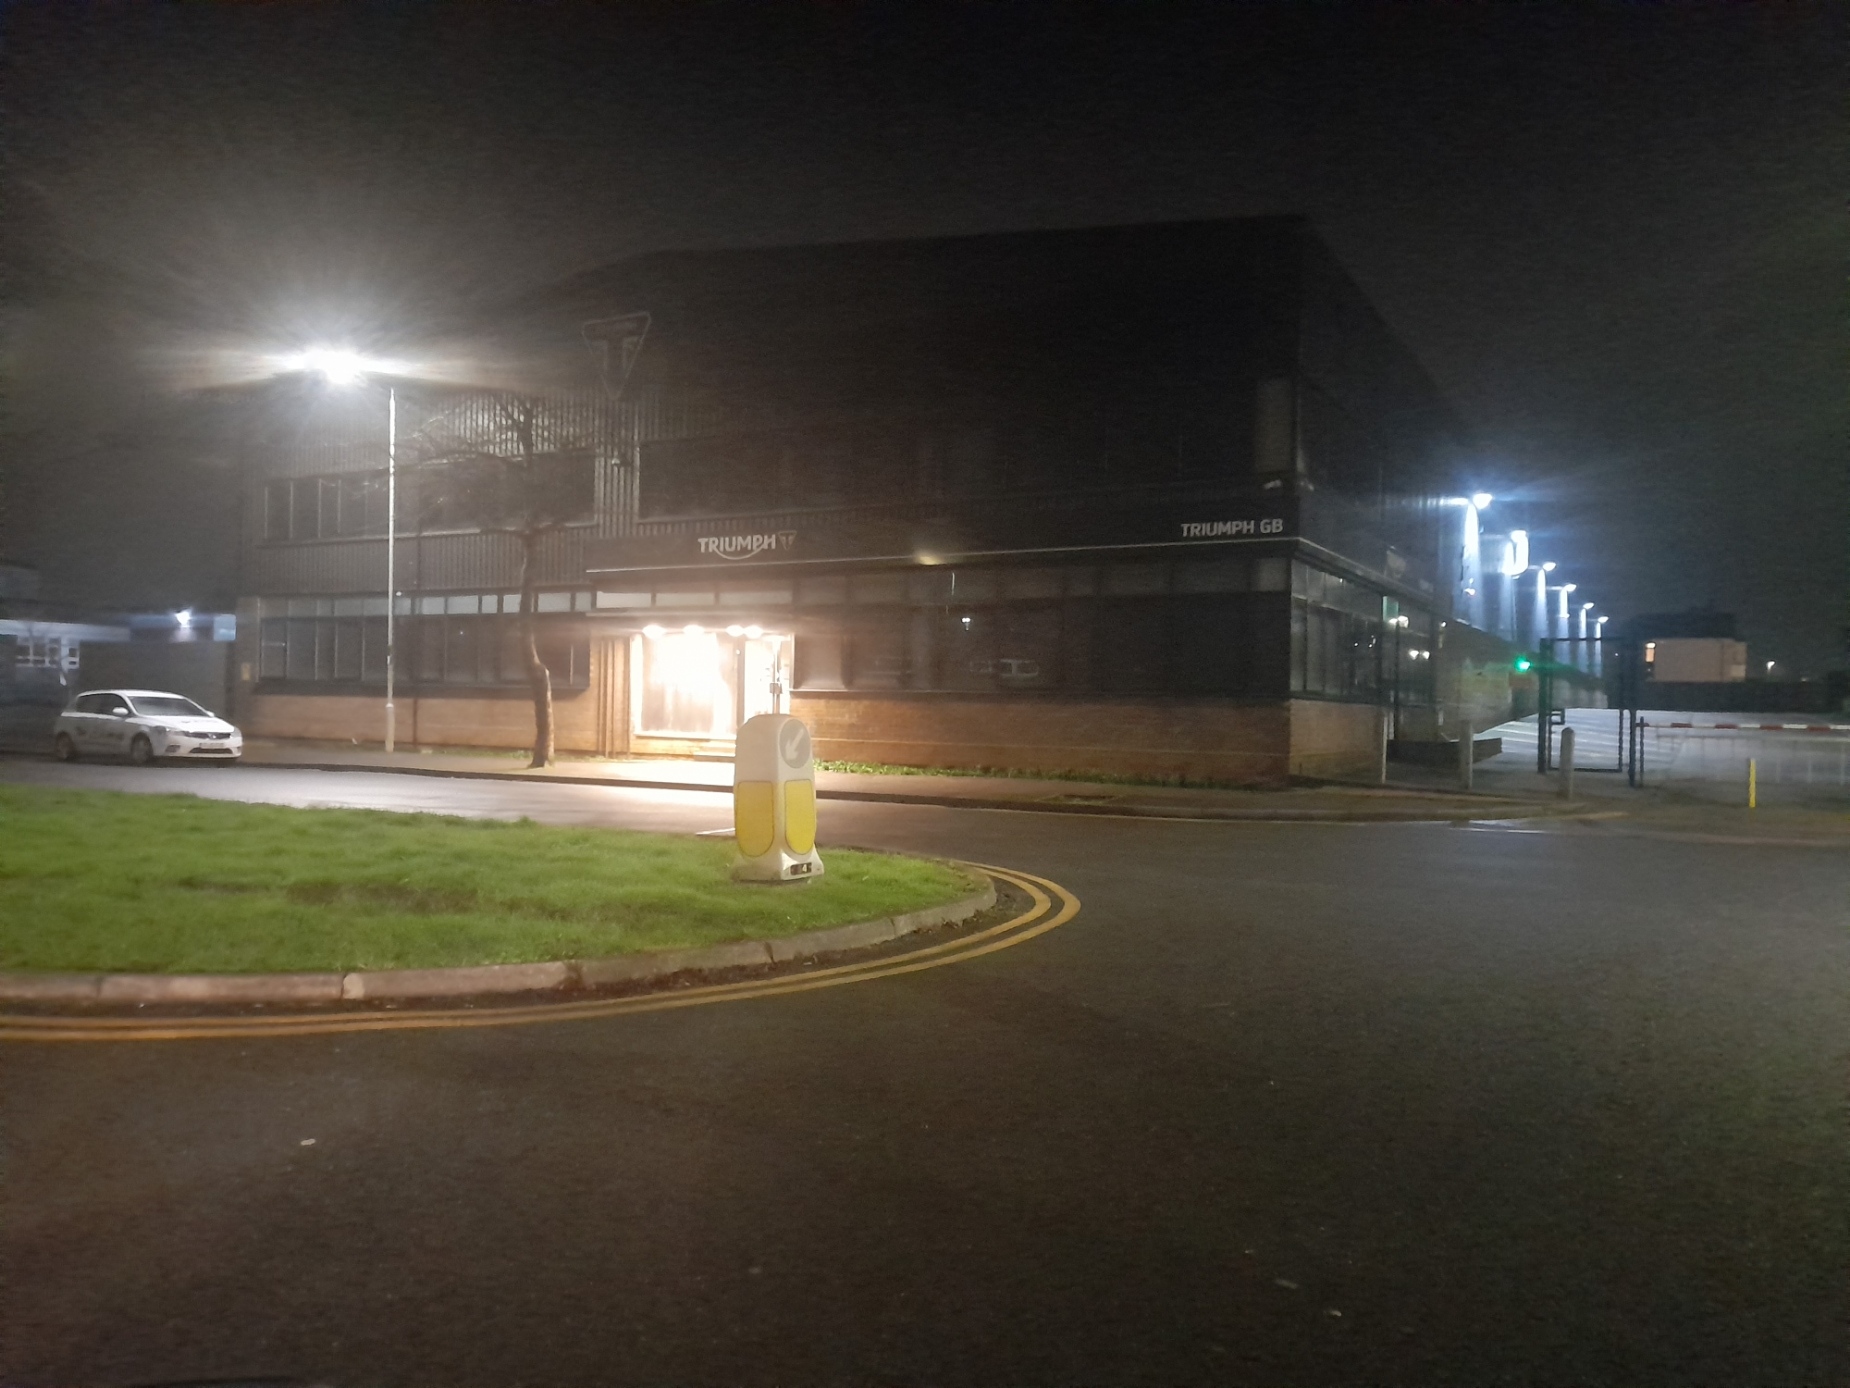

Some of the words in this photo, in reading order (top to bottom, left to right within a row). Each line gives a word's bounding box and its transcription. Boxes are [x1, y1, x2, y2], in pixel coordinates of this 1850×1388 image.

[1180, 520, 1255, 537] TRIUMPH
[1260, 519, 1283, 534] GB
[698, 534, 776, 559] TRIUMPH
